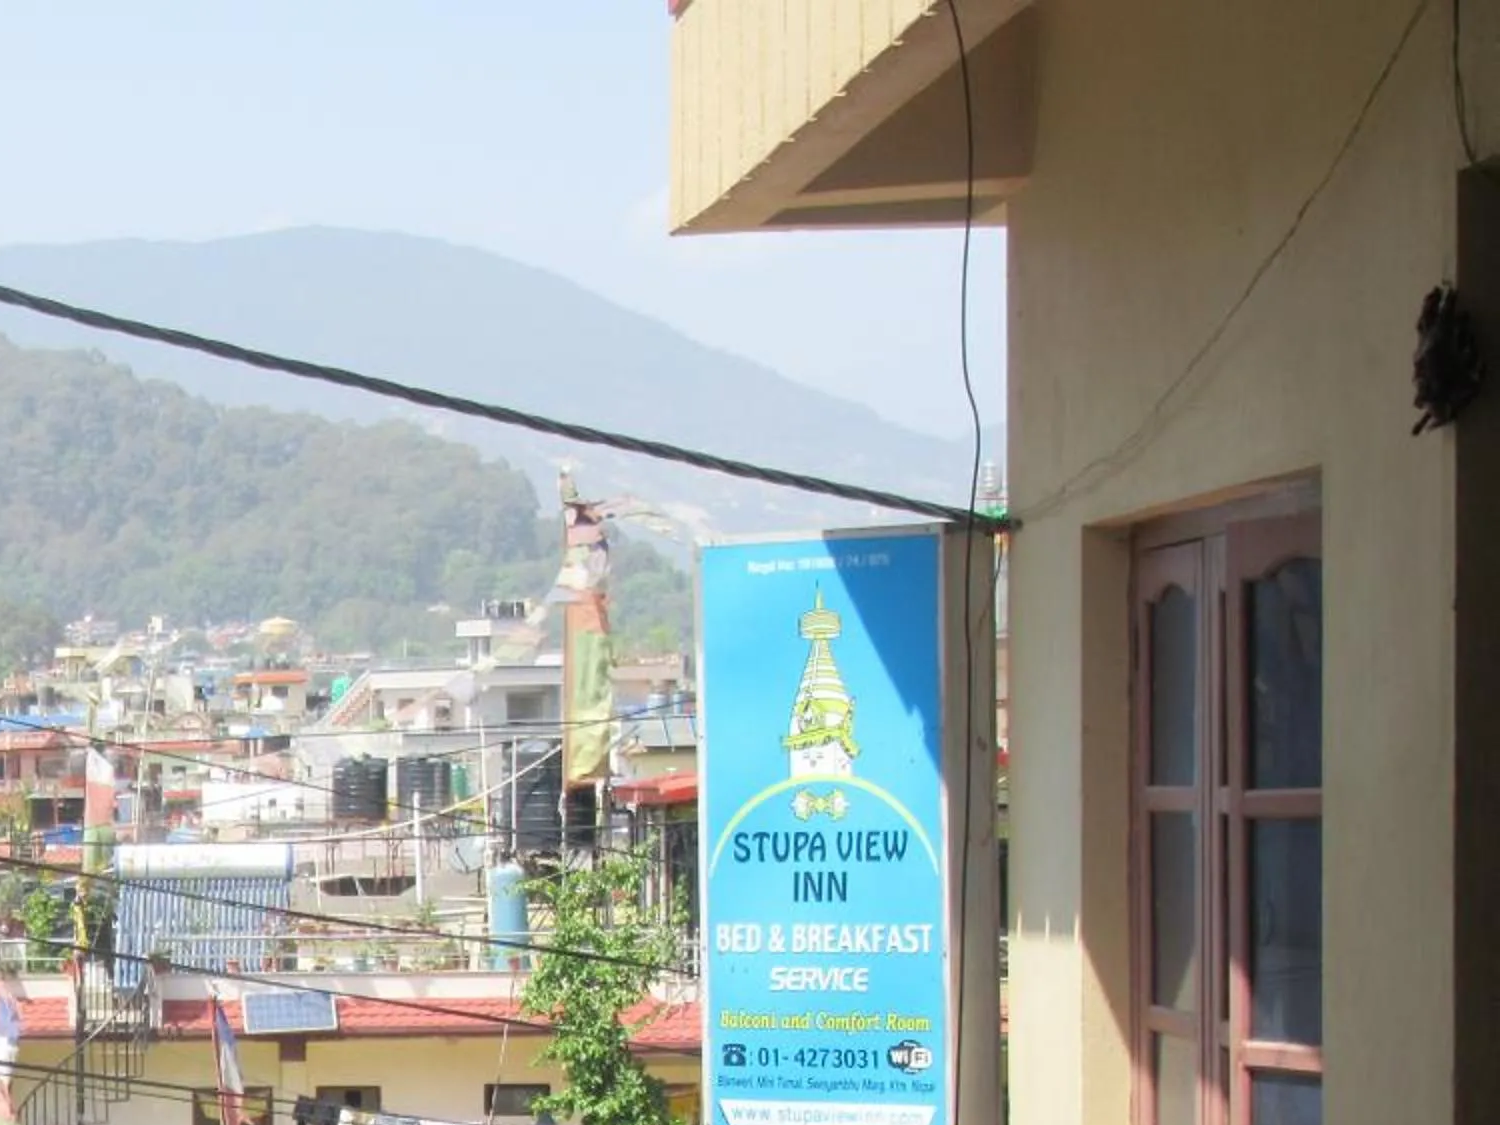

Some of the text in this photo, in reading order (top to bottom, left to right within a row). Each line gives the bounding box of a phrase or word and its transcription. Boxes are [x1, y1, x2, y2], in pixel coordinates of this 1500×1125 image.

[733, 830, 909, 862] STUPA VIEW
[793, 871, 848, 902] INN
[716, 923, 933, 953] BED & BREAKFAST
[769, 967, 869, 992] SERVICE
[720, 1010, 931, 1034] Balconi and Comfort Room
